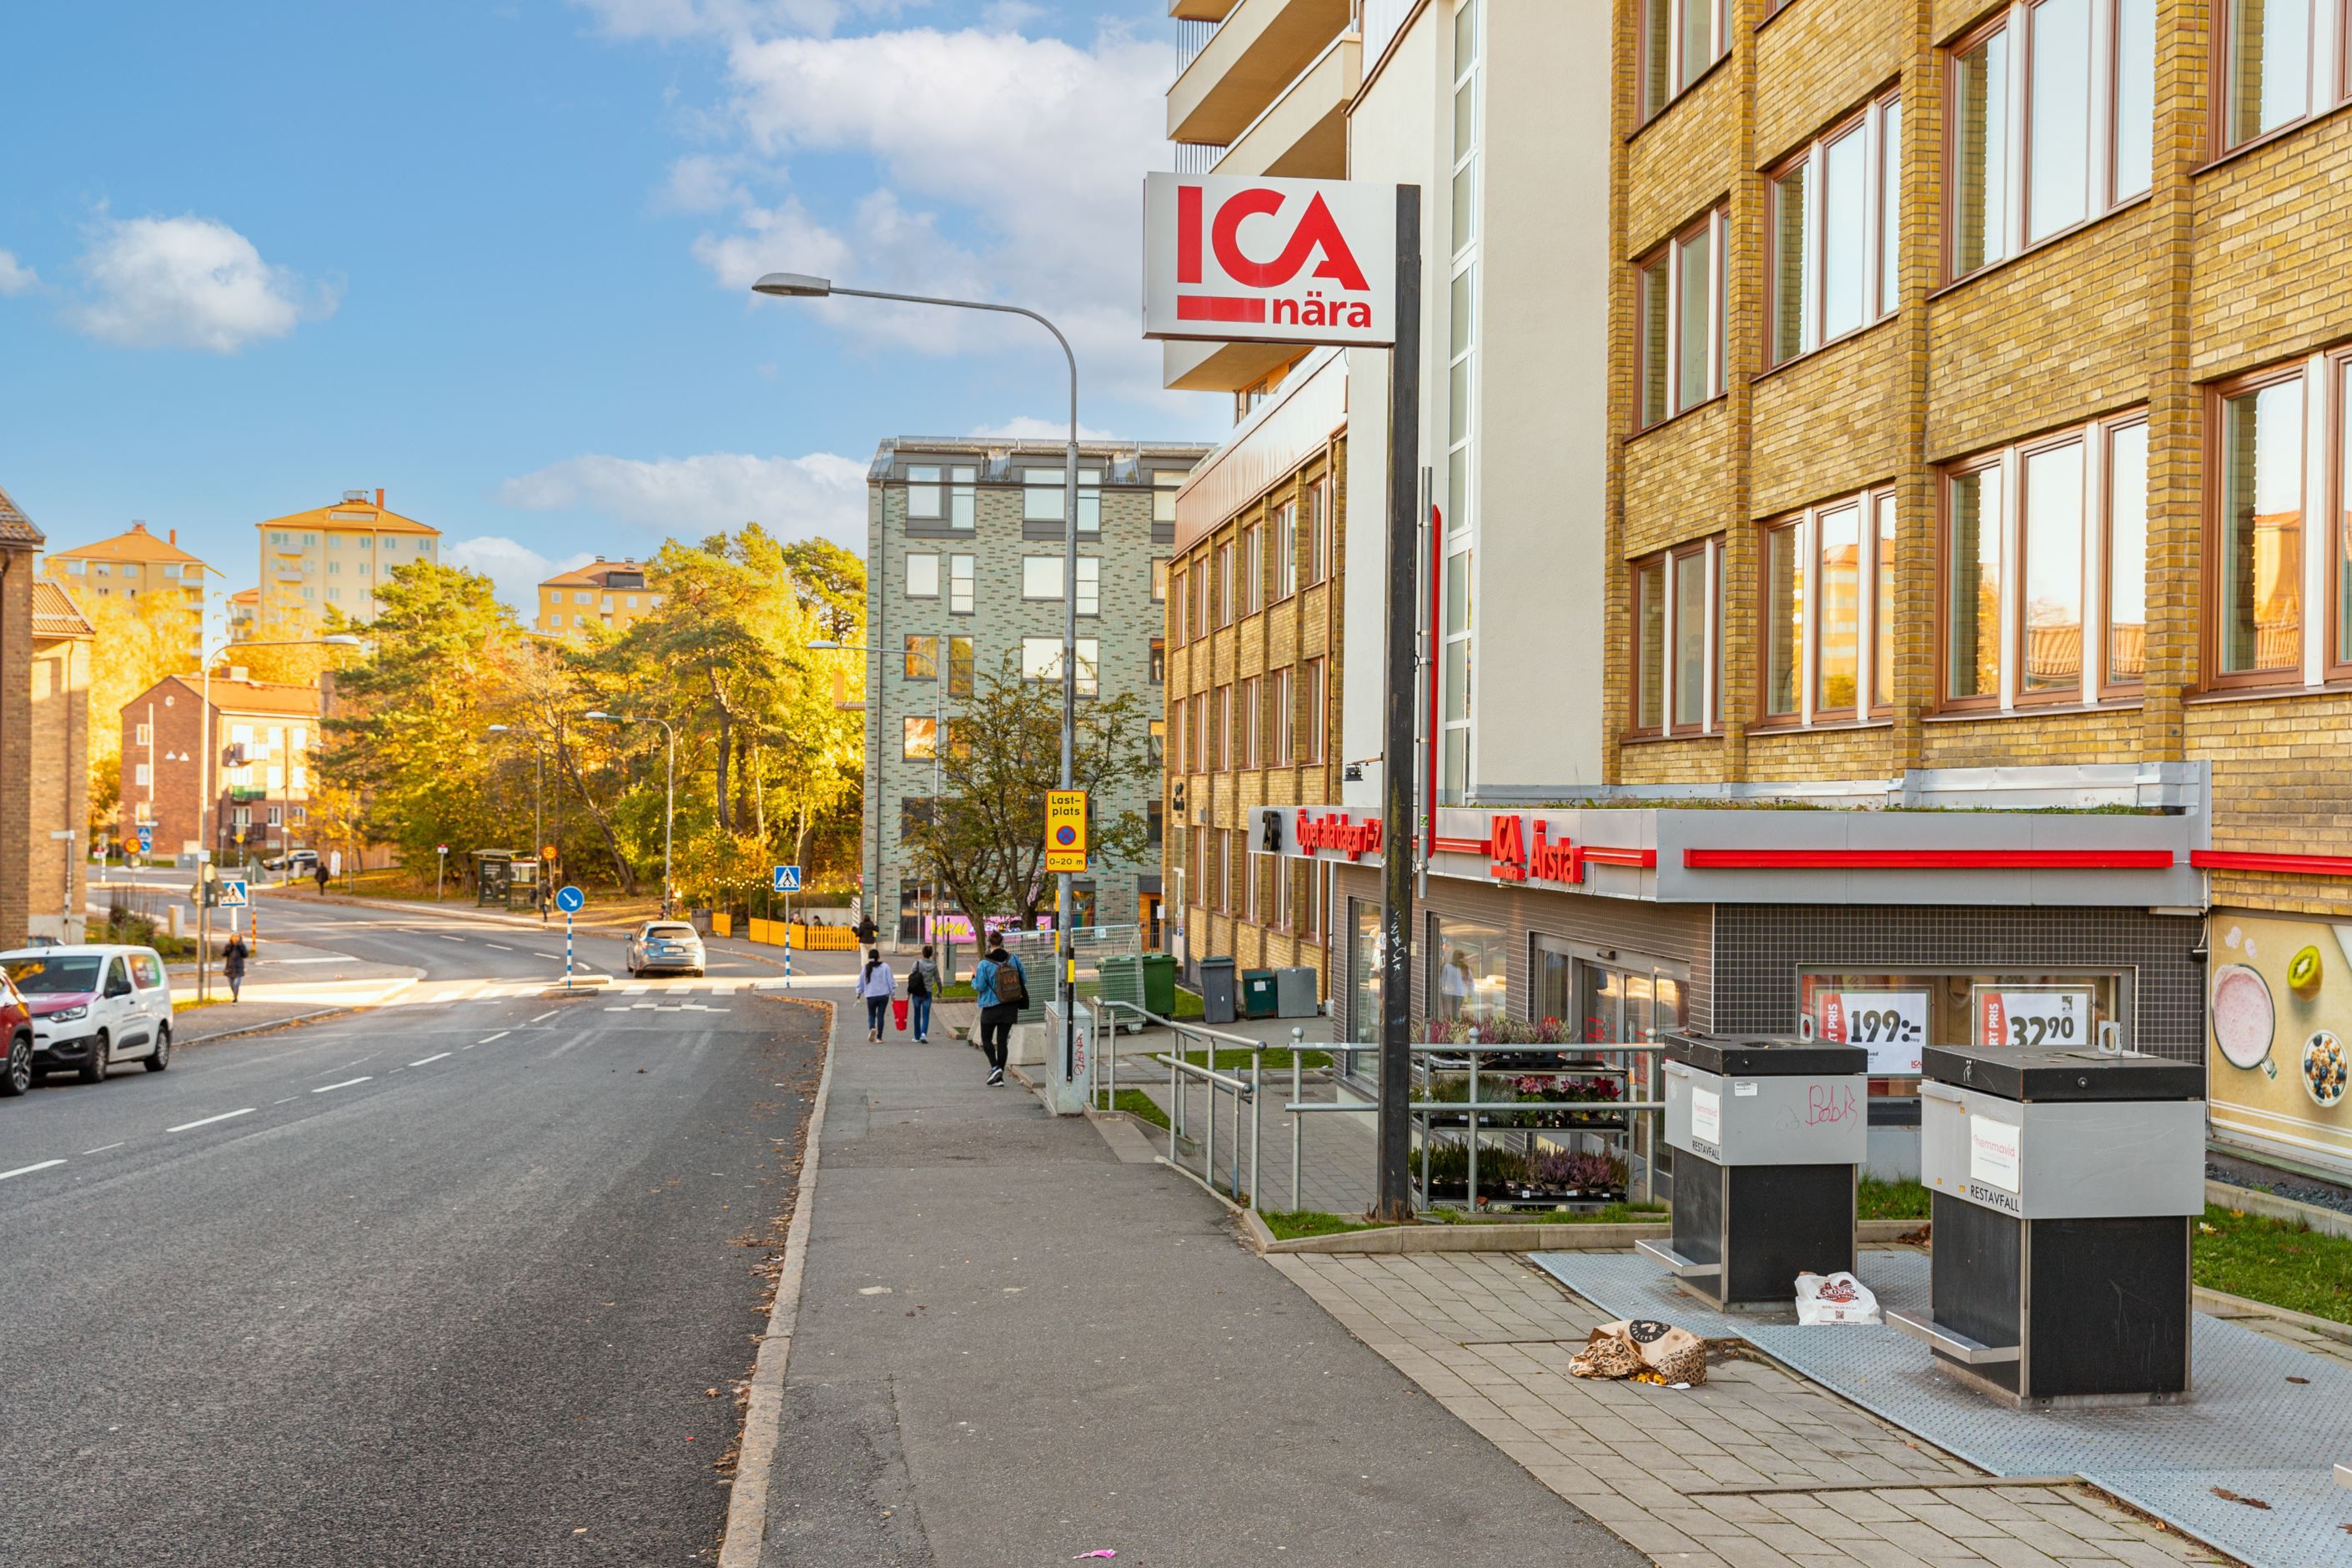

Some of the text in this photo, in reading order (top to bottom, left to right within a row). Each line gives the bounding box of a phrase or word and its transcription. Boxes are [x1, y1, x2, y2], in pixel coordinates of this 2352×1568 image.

[1177, 185, 1370, 291] ICA
[1272, 290, 1371, 328] nära
[1051, 795, 1081, 805] Last-
[1052, 807, 1080, 817] plats
[1296, 808, 1323, 856] Öppet
[1319, 813, 1338, 849] alla
[1336, 814, 1362, 861] dagar
[1490, 815, 1525, 863] ICA
[1048, 857, 1073, 866] 0-20
[1529, 820, 1583, 883] Årsta
[1828, 1003, 1838, 1029] PRIS
[1988, 1003, 1999, 1028] PRIS
[1691, 1140, 1721, 1161] RESTAVFALL
[1970, 1184, 2020, 1213] RESTAVFALL
